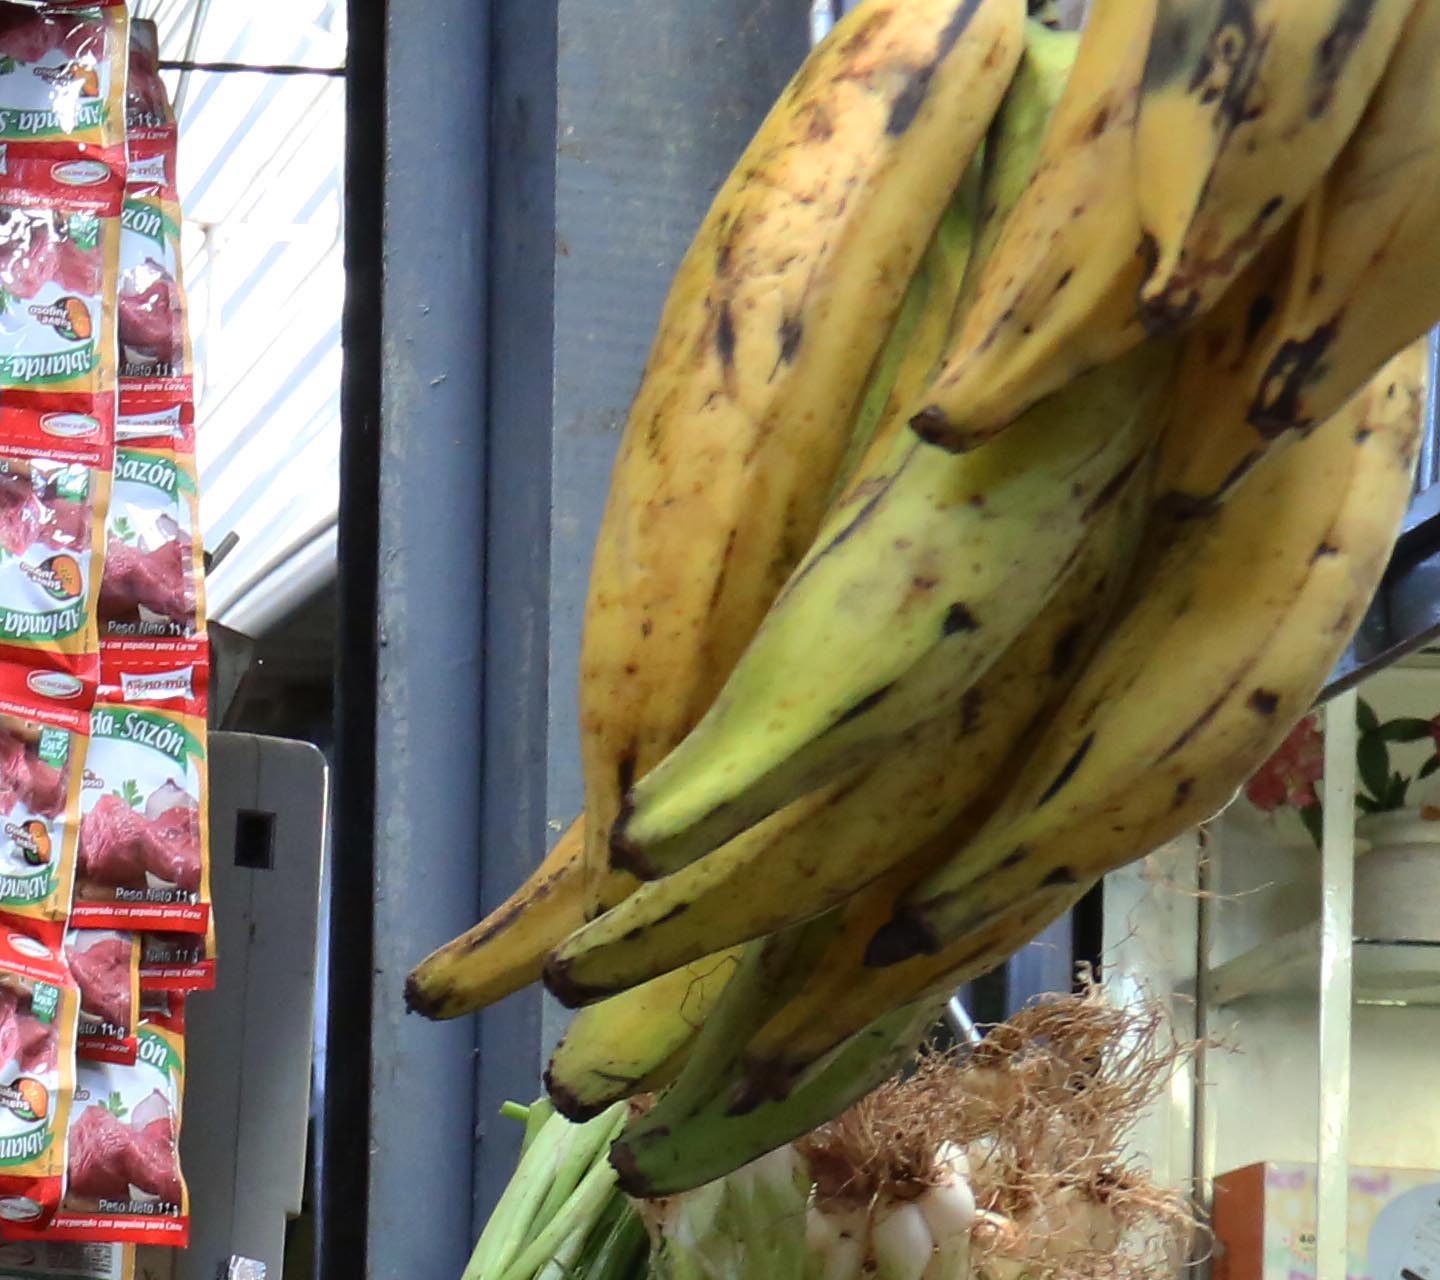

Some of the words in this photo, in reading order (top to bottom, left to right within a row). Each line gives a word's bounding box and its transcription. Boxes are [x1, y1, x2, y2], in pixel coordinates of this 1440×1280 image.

[107, 620, 135, 634] Peso
[138, 621, 166, 635] Neto
[115, 887, 143, 900] Peso
[144, 888, 173, 902] Neto
[98, 1200, 126, 1211] Peso
[130, 1200, 153, 1214] Neto
